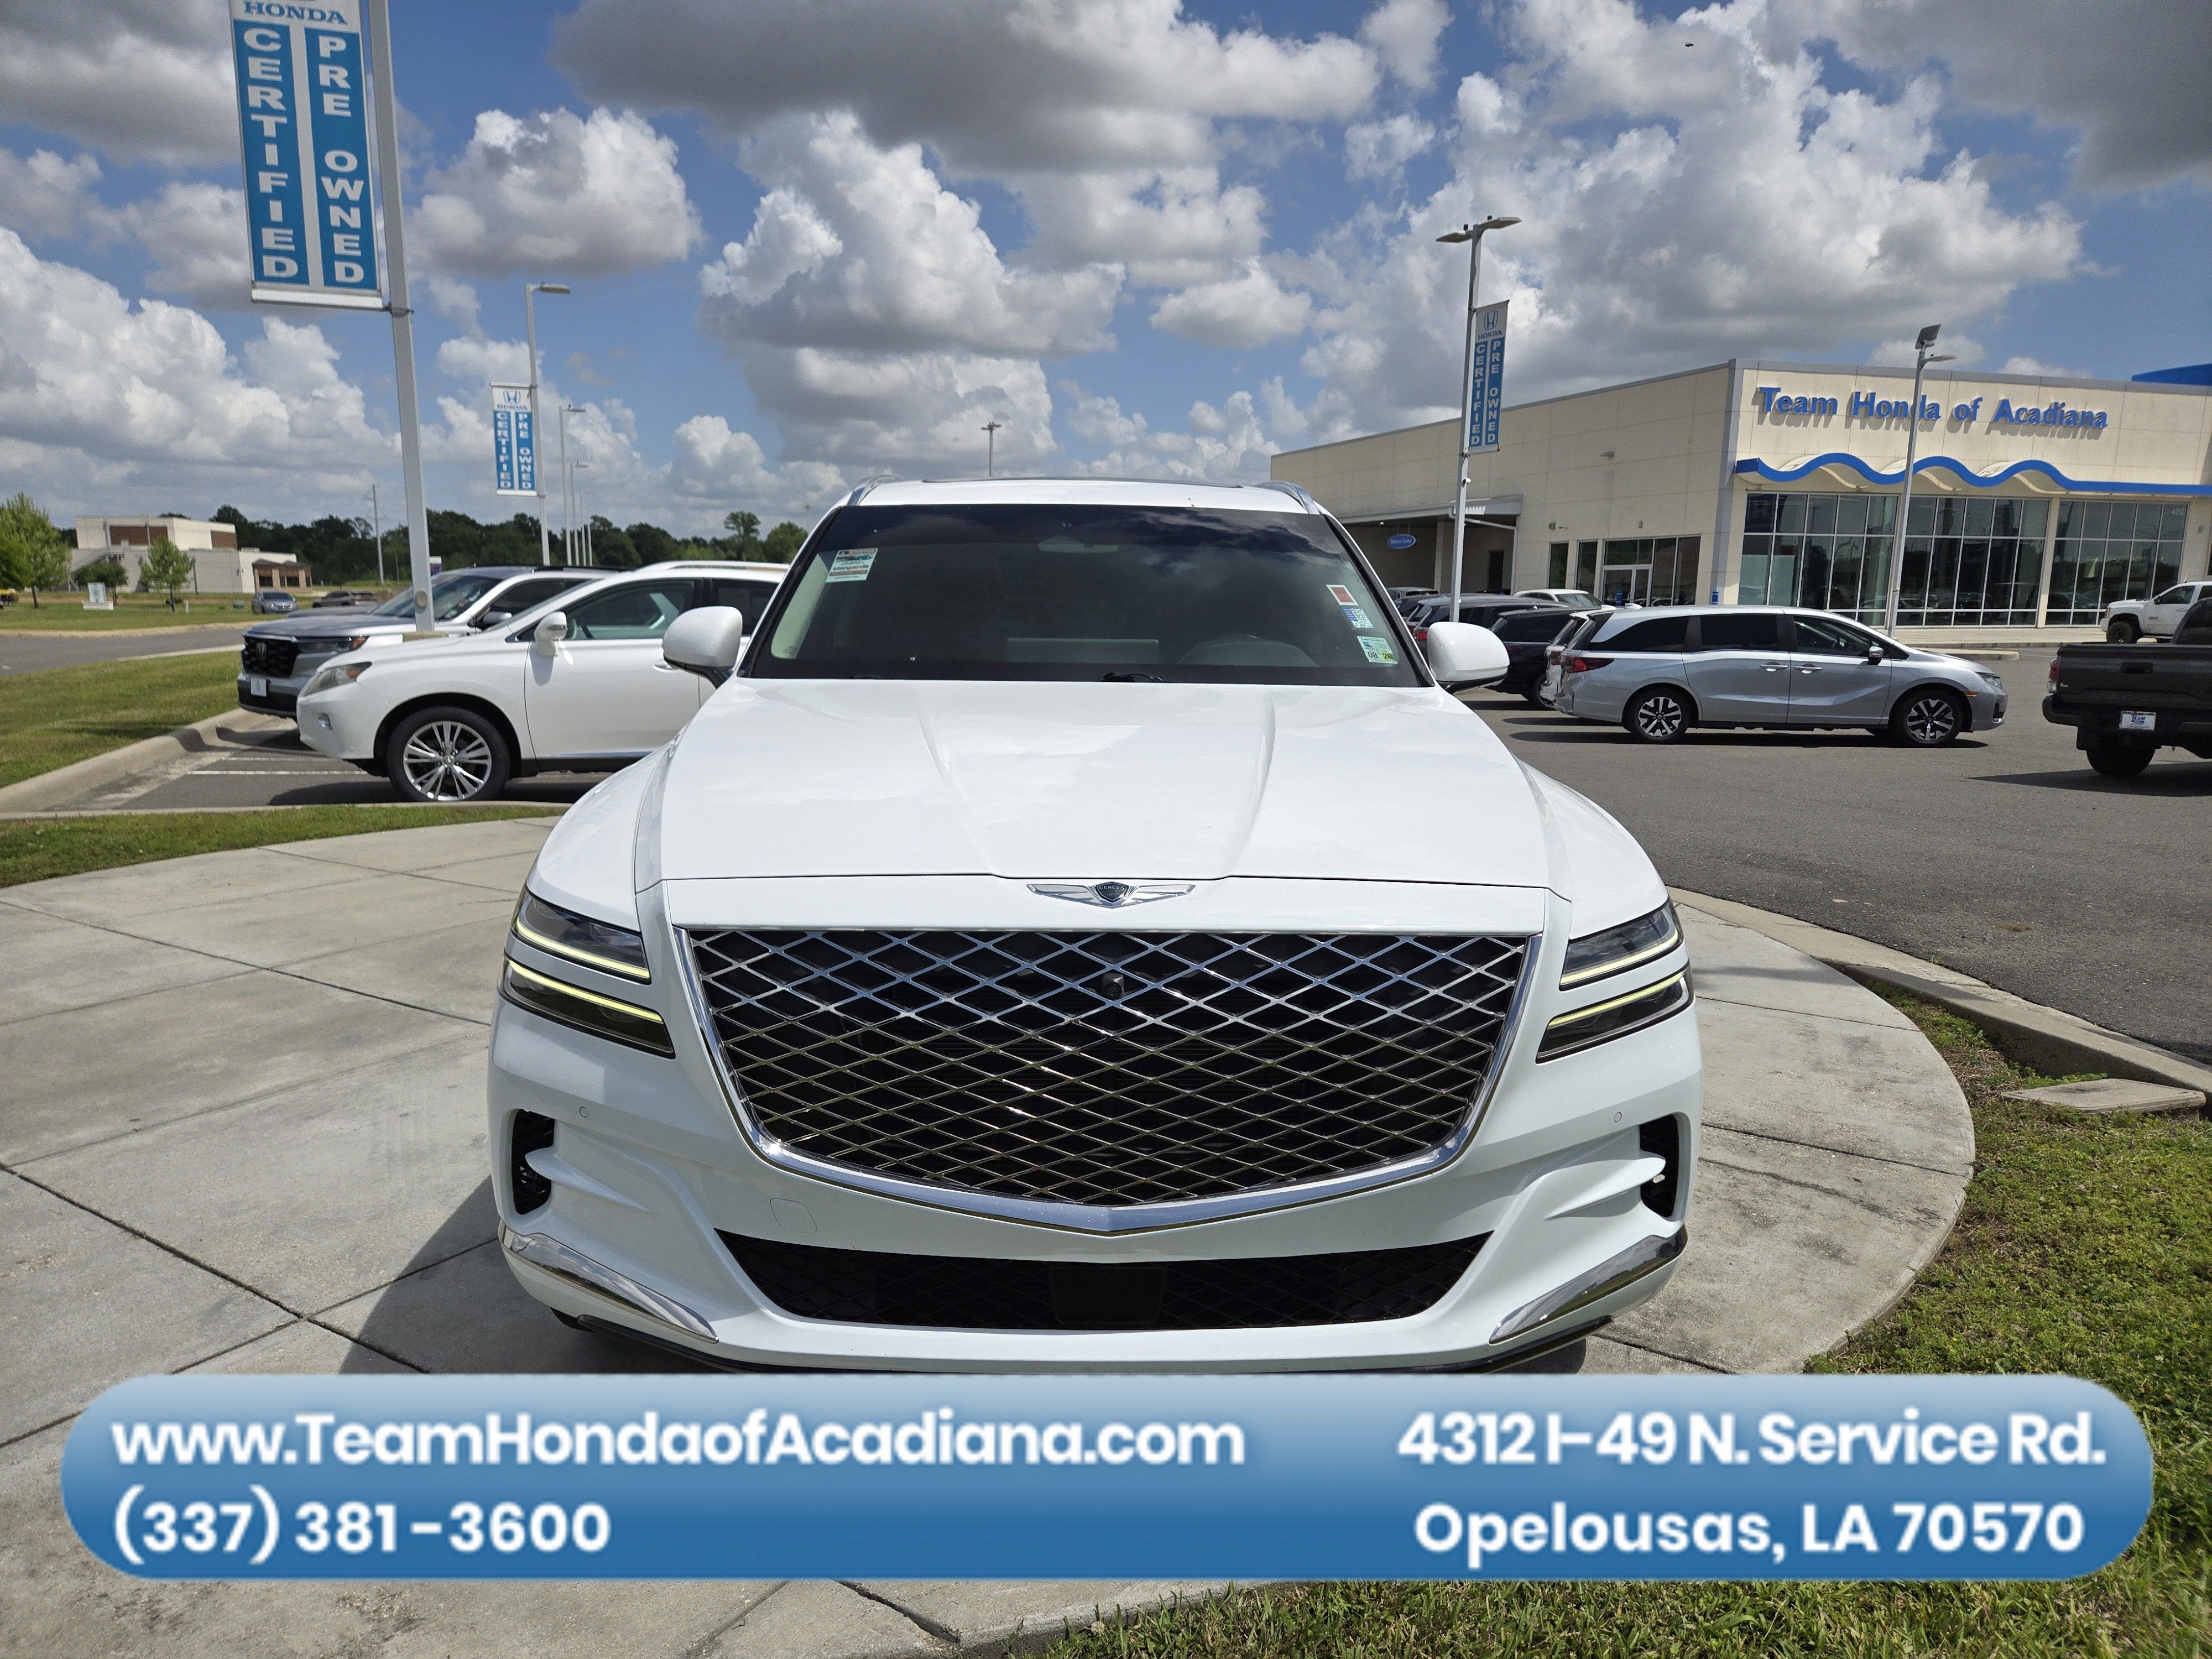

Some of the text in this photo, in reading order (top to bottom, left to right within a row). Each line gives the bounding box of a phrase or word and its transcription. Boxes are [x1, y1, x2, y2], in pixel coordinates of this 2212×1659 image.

[243, 1, 348, 25] HONDA
[243, 27, 299, 278] CERTIFIED
[318, 35, 364, 284] PRE OWNED
[1478, 330, 1503, 340] HONDA
[1471, 344, 1485, 446] CERTIFIED
[1488, 340, 1501, 443] PRE OWNED
[1760, 387, 1838, 415] Team
[1954, 397, 1983, 422] of
[1993, 398, 2109, 429] Acadiana
[497, 412, 512, 488] CERTIFIED
[519, 413, 533, 489] PRE OWNED
